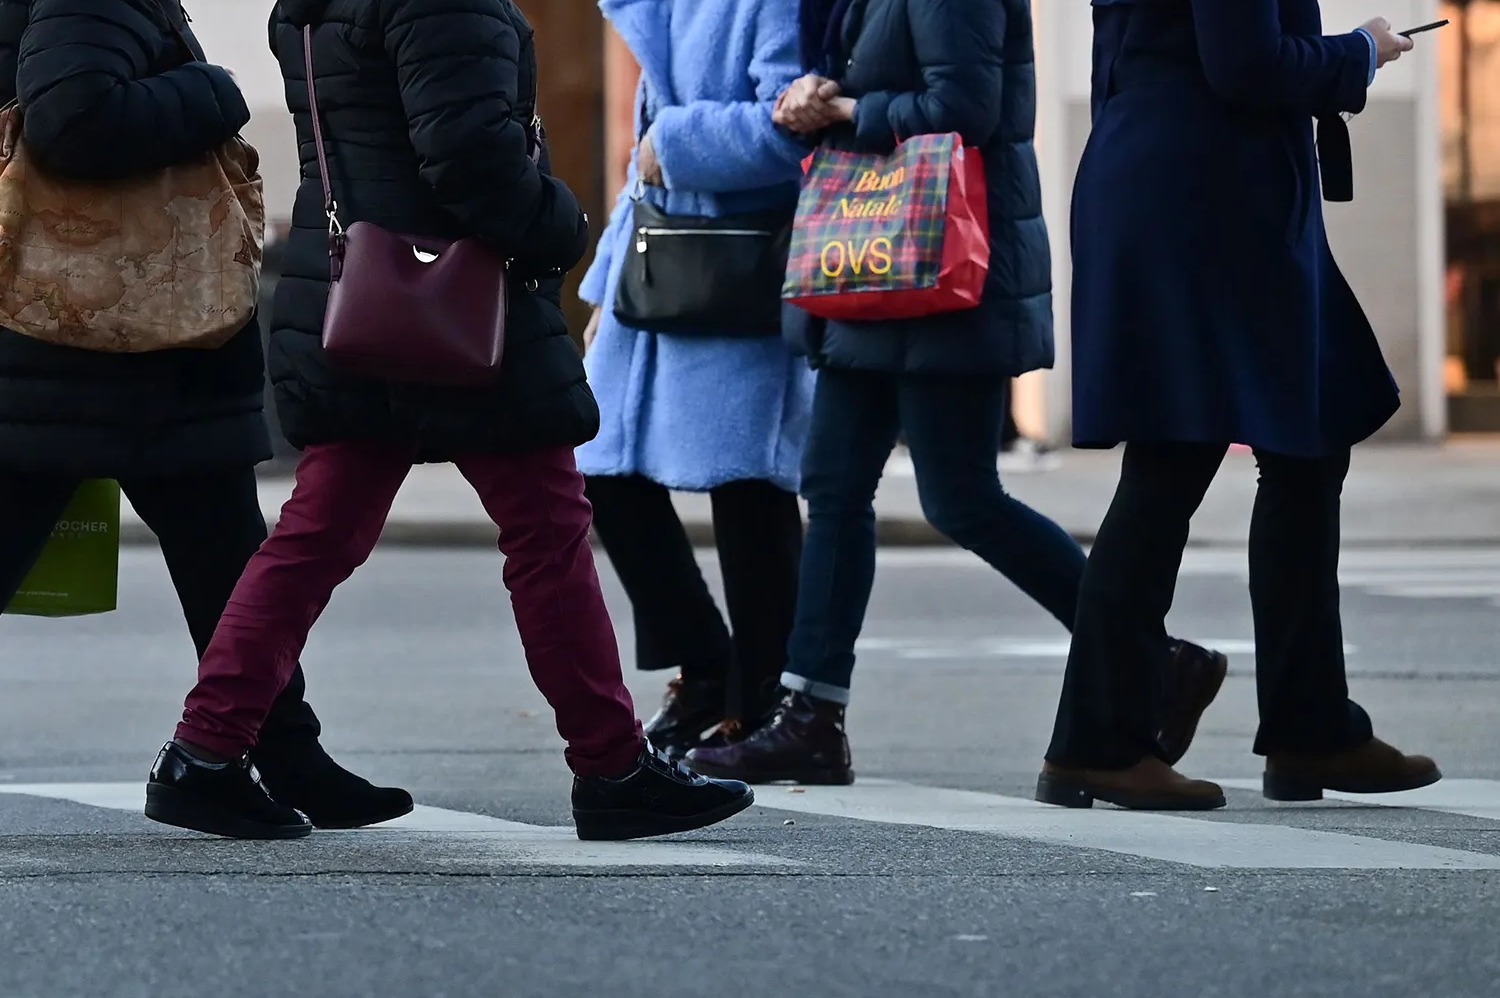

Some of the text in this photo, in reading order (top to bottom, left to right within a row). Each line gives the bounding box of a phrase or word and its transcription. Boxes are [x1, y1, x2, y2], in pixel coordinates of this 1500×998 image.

[853, 166, 905, 192] Buon
[831, 194, 903, 220] Natale
[820, 236, 892, 277] OVS
